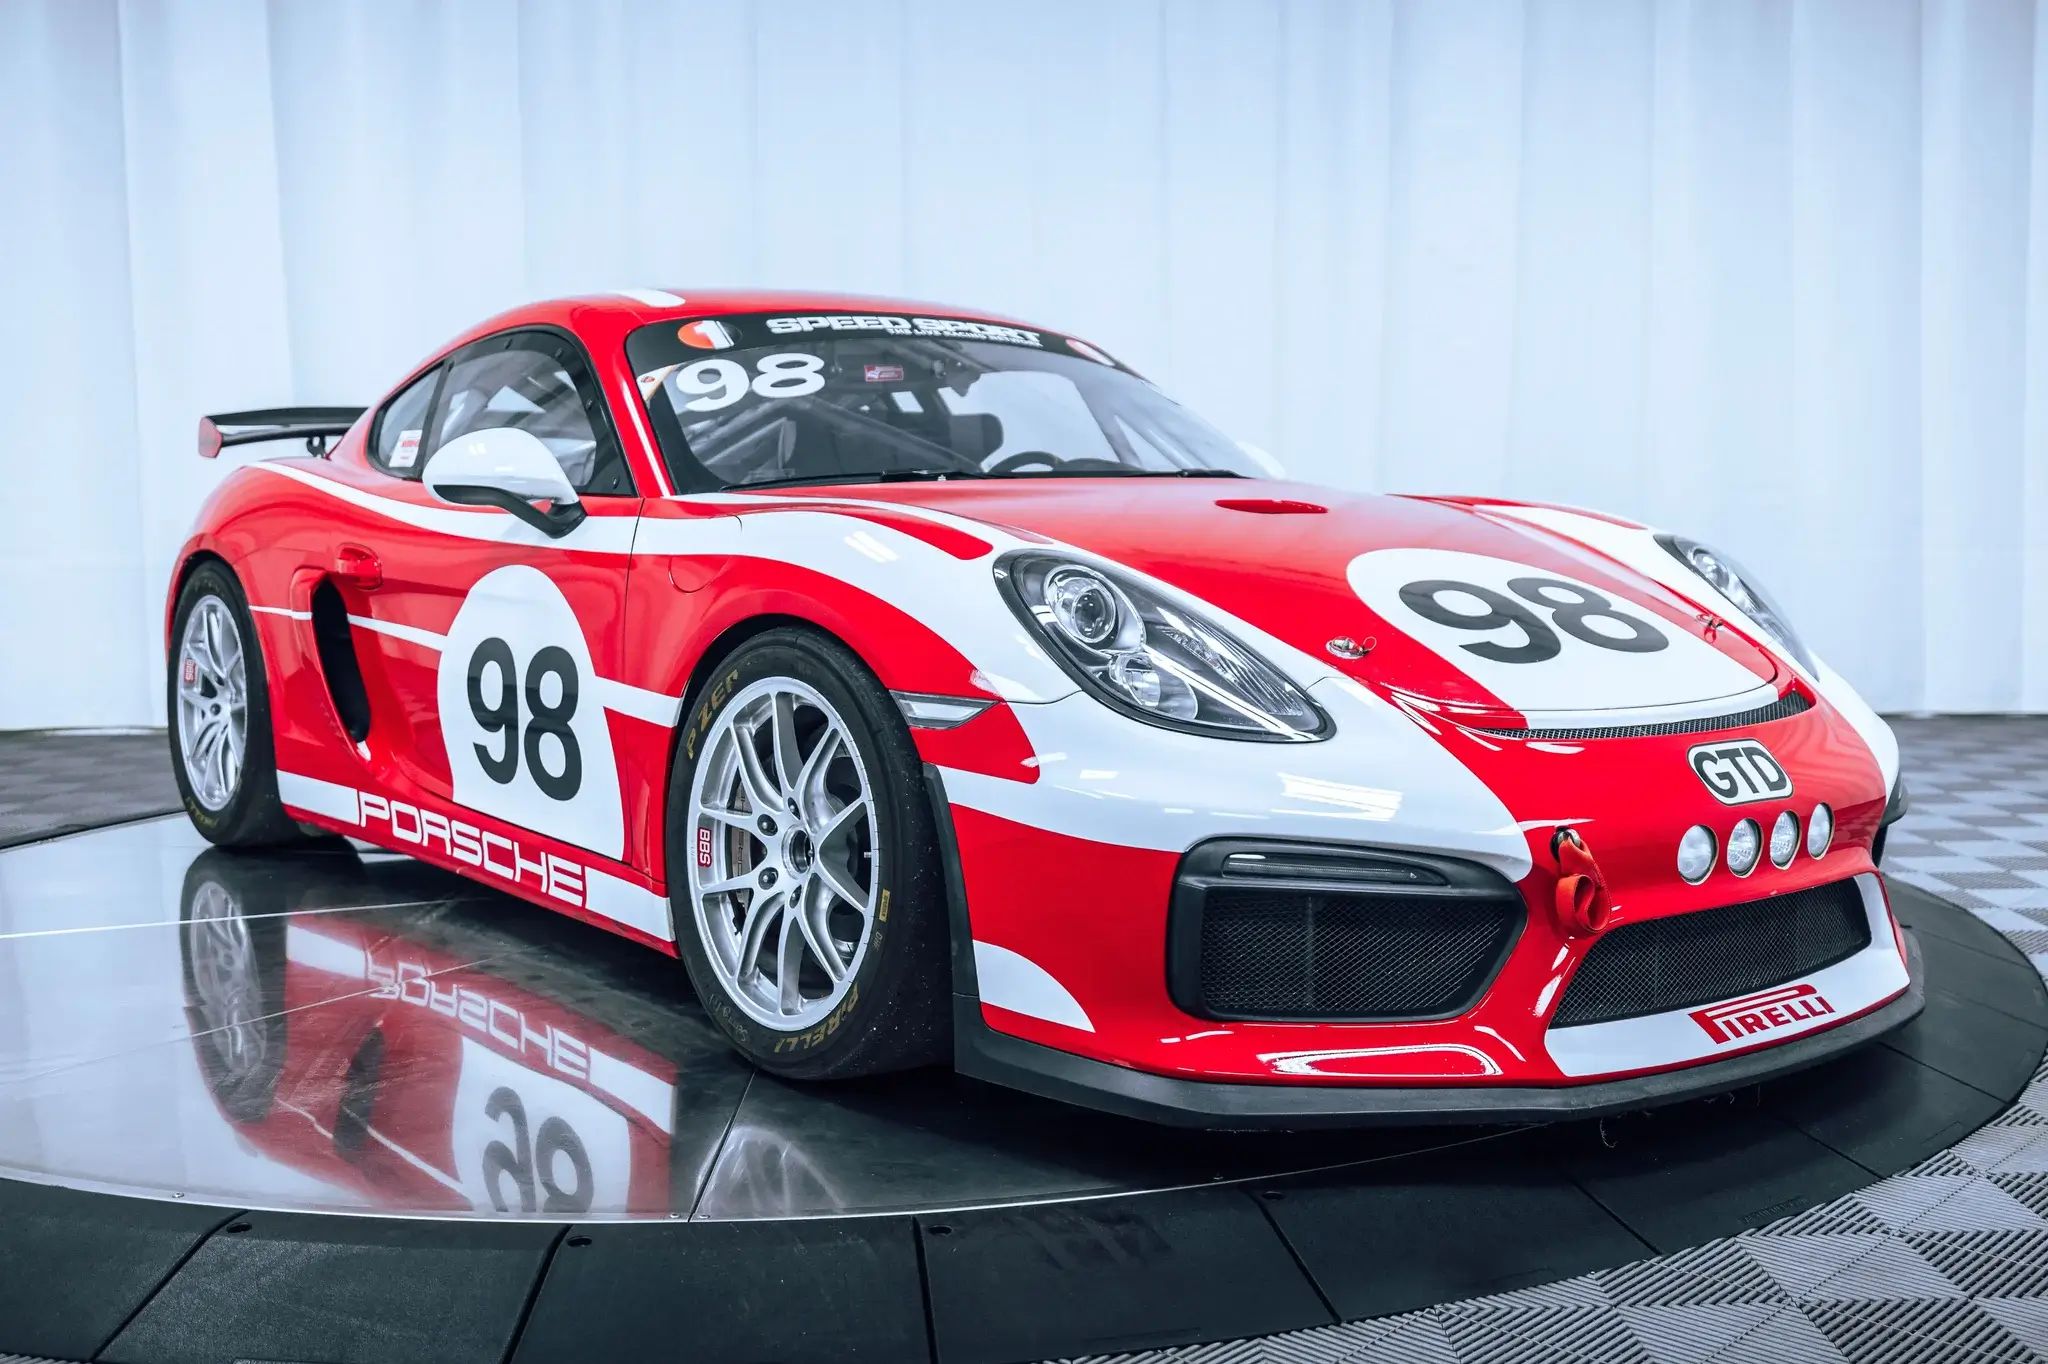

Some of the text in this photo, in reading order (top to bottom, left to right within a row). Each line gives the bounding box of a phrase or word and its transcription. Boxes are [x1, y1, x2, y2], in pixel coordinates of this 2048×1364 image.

[766, 316, 1041, 343] SPEED SPORT
[676, 353, 826, 412] 98
[1399, 577, 1670, 664] 98
[467, 636, 582, 801] 98
[1693, 746, 1788, 798] GTD
[359, 791, 584, 908] PORSCHE
[699, 827, 711, 866] BBS
[774, 982, 859, 1053] PIRELLI
[1687, 984, 1836, 1045] PIRELLI
